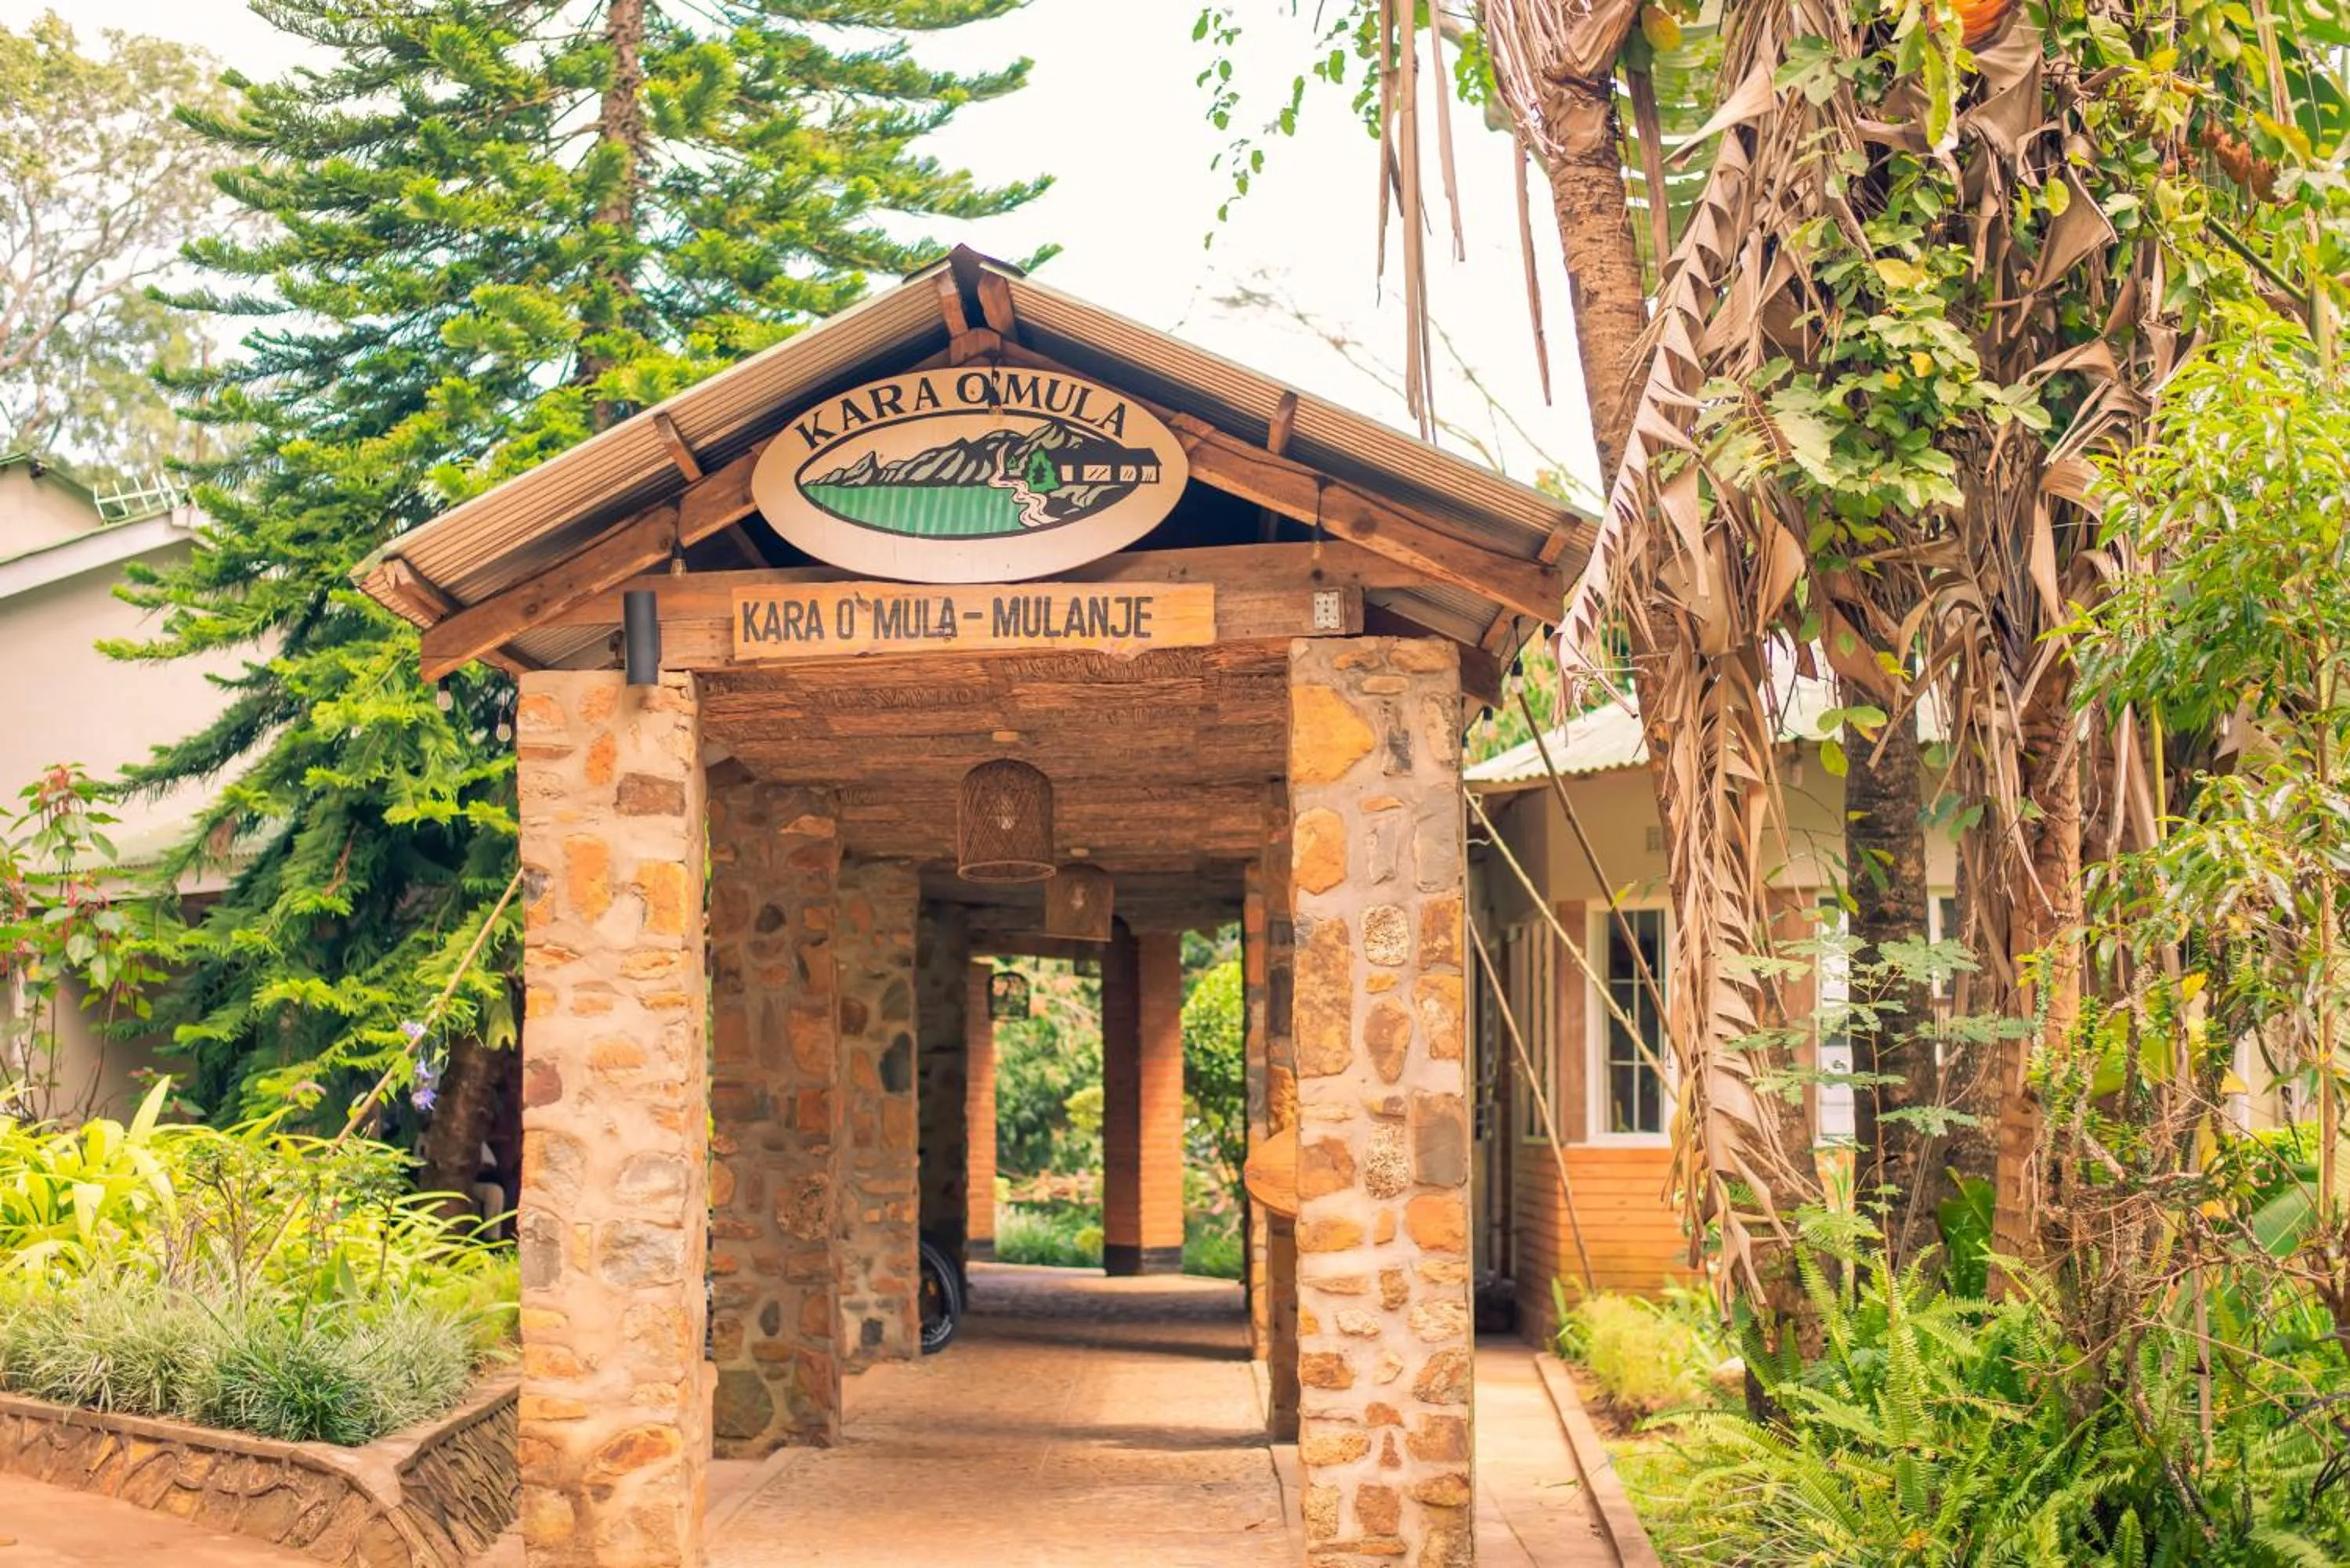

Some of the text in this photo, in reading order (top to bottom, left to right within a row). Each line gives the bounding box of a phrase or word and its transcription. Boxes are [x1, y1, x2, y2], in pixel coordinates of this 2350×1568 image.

[794, 370, 1126, 451] KARA O'MULA
[743, 599, 825, 642] KARA
[992, 595, 1154, 638] MULANJE
